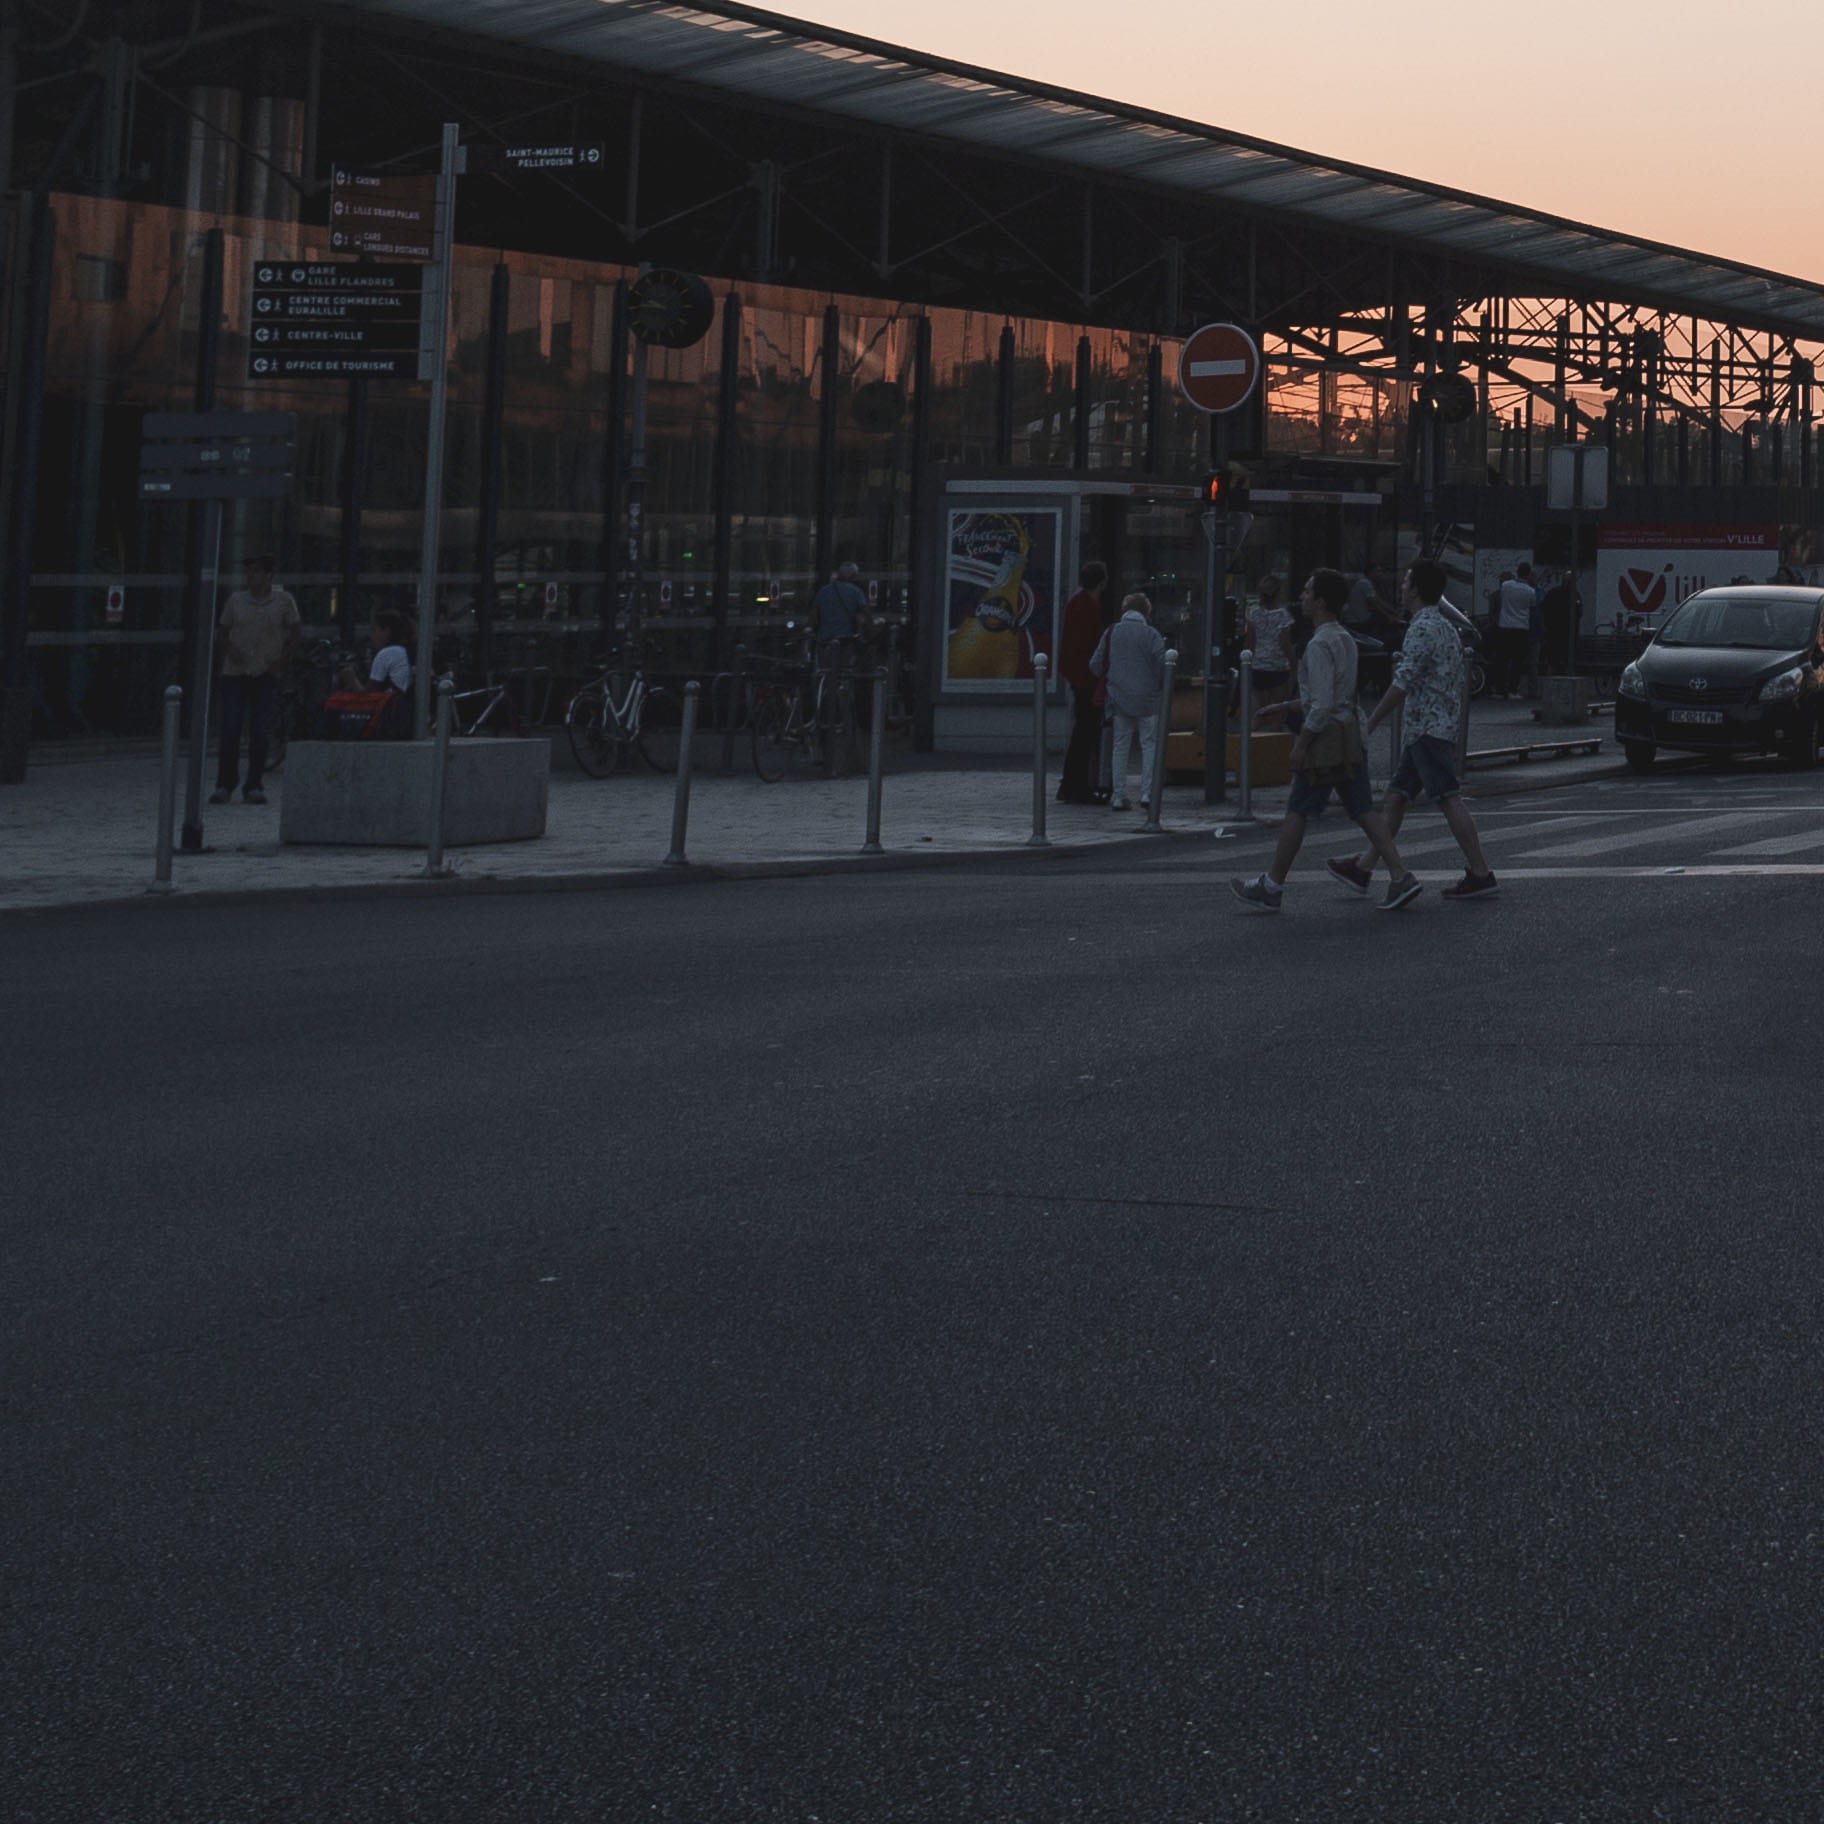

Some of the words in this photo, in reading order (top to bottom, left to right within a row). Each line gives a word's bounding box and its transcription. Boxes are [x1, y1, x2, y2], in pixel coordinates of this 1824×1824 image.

[505, 146, 574, 158] SAINT-MAURICE
[517, 157, 574, 168] PELLEVOISIN
[307, 266, 336, 275] GARE
[307, 276, 336, 286] LILLE
[339, 277, 395, 287] FLANDRES
[288, 295, 330, 305] CENTRE
[333, 296, 401, 306] COMMERCIAL
[288, 306, 347, 316] EURALILLE
[286, 330, 364, 341] CENTRE-VILLE
[285, 360, 322, 371] OFFICE
[325, 360, 339, 371] DE
[342, 360, 395, 371] TOURISME
[1727, 534, 1765, 545] V'LILLE
